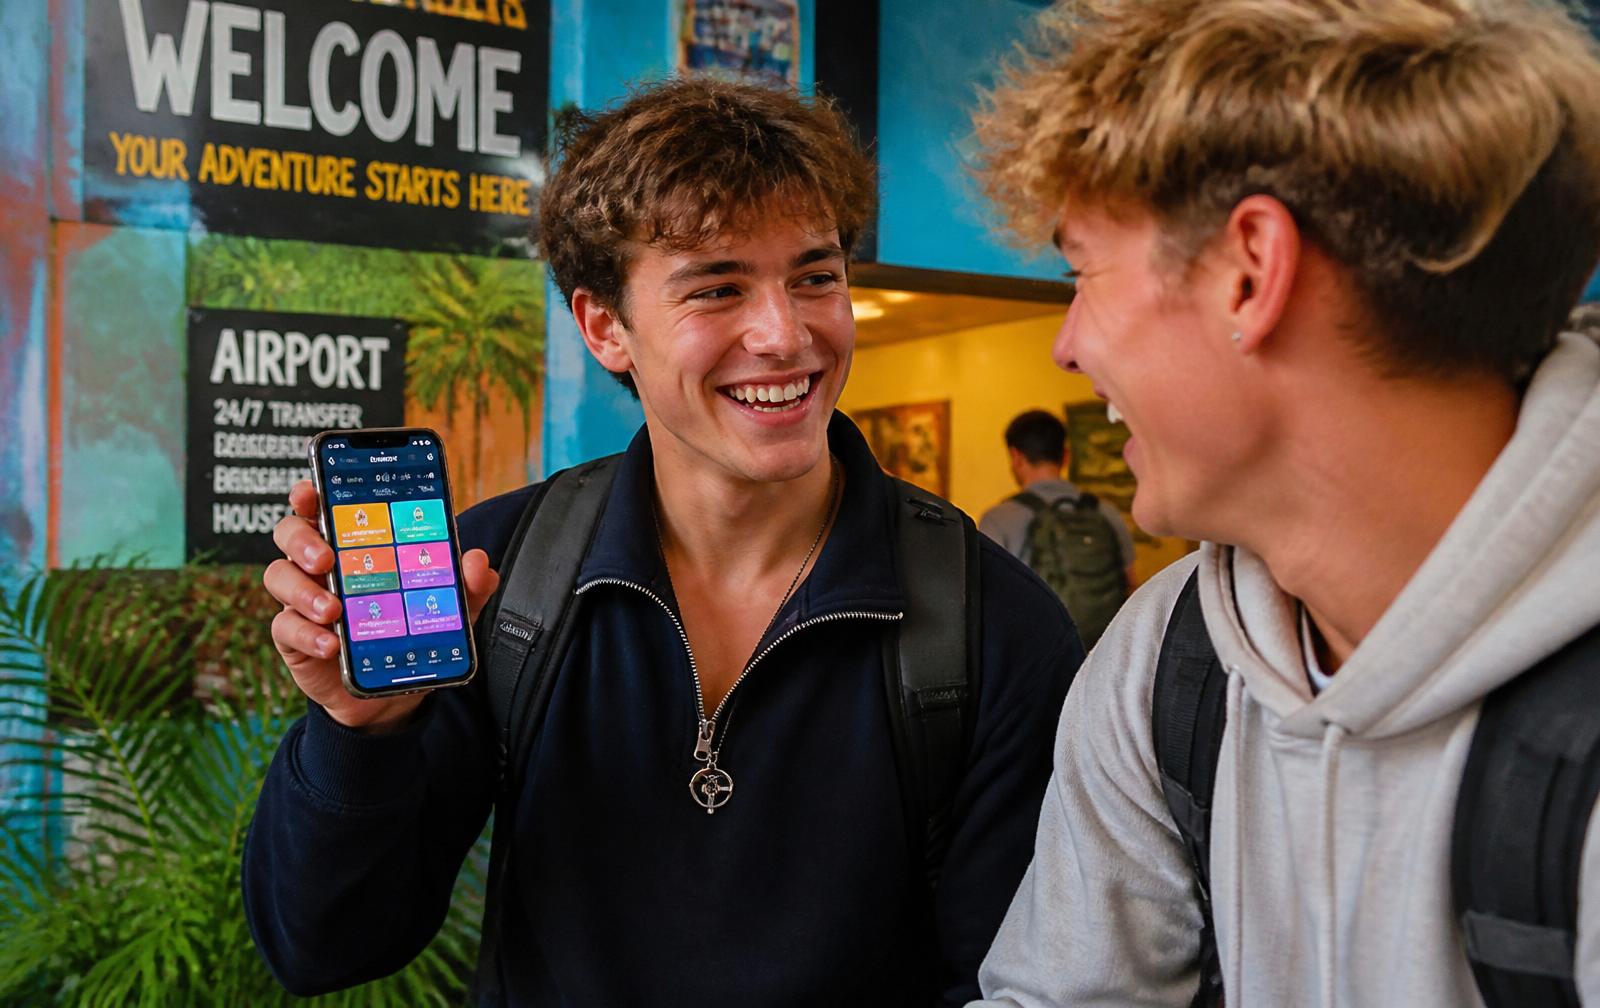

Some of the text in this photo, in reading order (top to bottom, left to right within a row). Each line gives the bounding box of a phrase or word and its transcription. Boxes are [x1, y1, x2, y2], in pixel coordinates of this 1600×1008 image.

[119, 0, 522, 158] WELCOME
[109, 131, 532, 217] YOUR ADVENTURE STARTS HERE
[210, 328, 390, 391] AIRPORT
[213, 397, 363, 429] 24/7 TRANSFER
[213, 502, 294, 534] HOUSE
